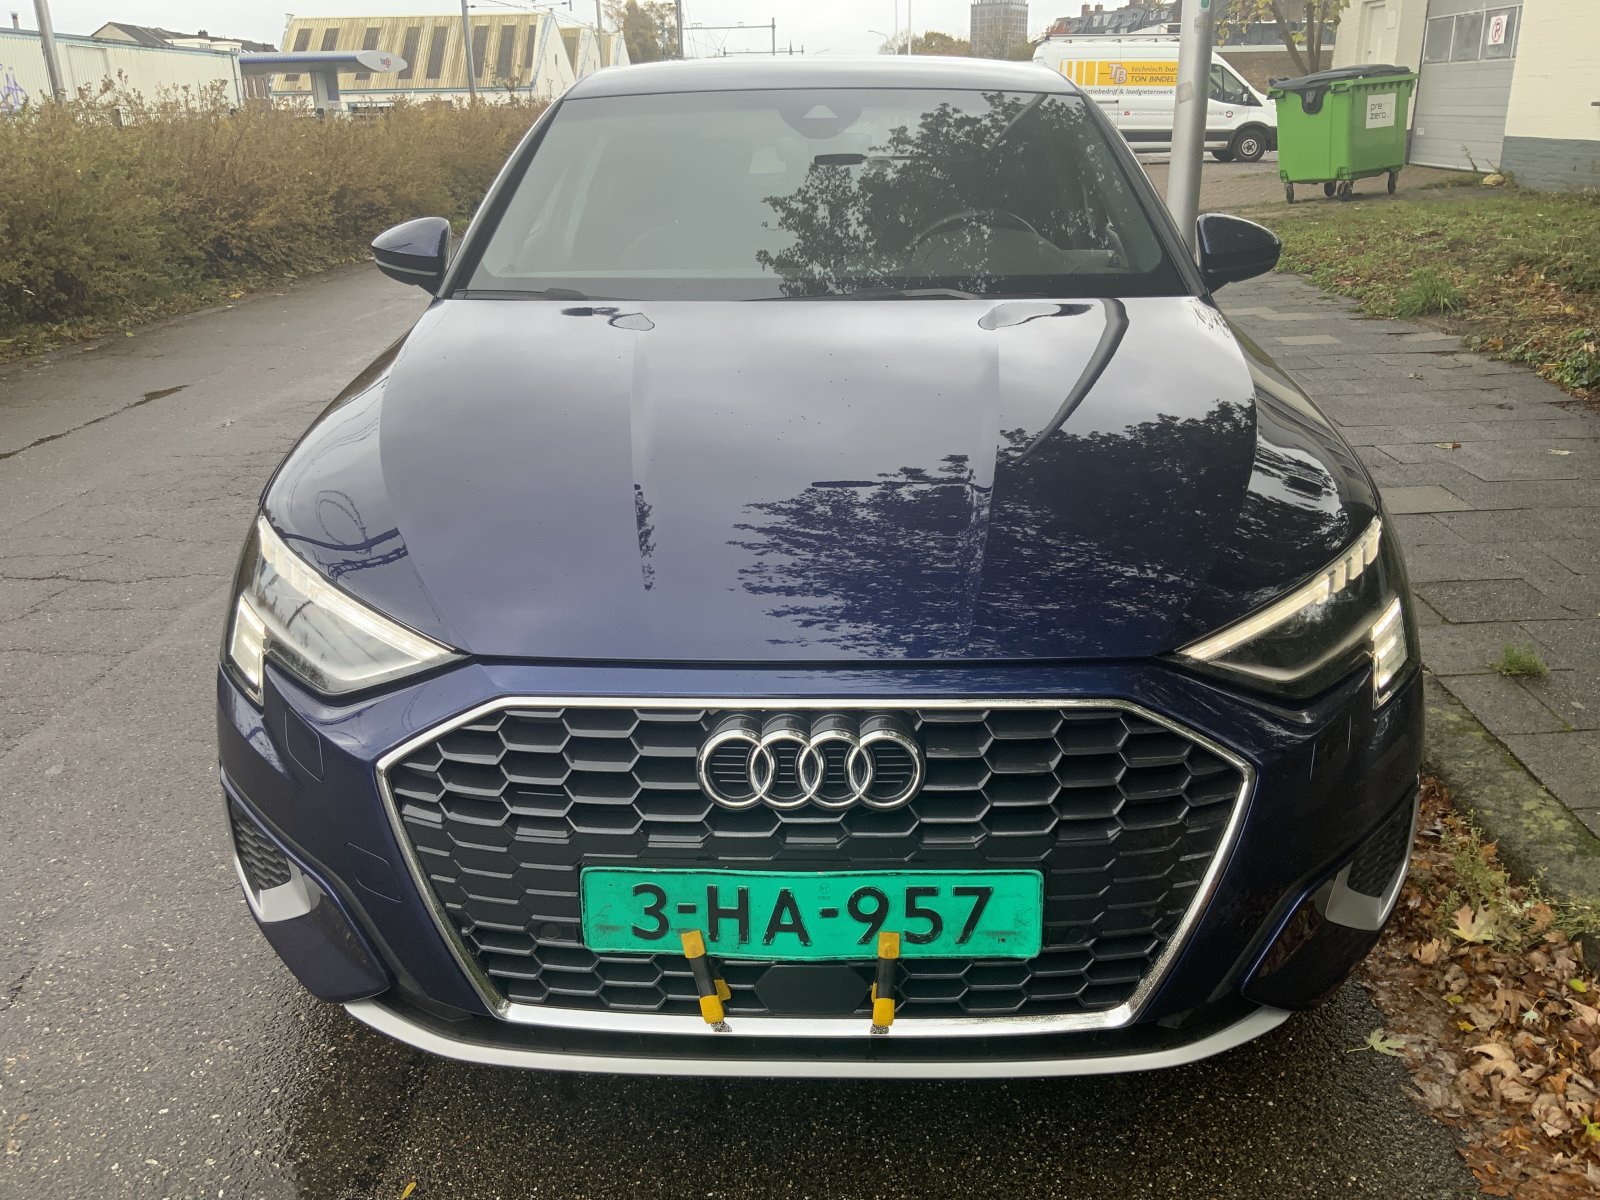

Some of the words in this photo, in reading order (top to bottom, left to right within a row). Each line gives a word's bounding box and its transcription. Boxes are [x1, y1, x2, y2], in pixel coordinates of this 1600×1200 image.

[1131, 65, 1163, 73] technisch
[1164, 65, 1178, 73] bur
[1130, 75, 1147, 83] TON
[1125, 88, 1174, 96] loodgieterswerk
[1370, 102, 1383, 112] pre
[631, 882, 995, 946] 3-HA-957
